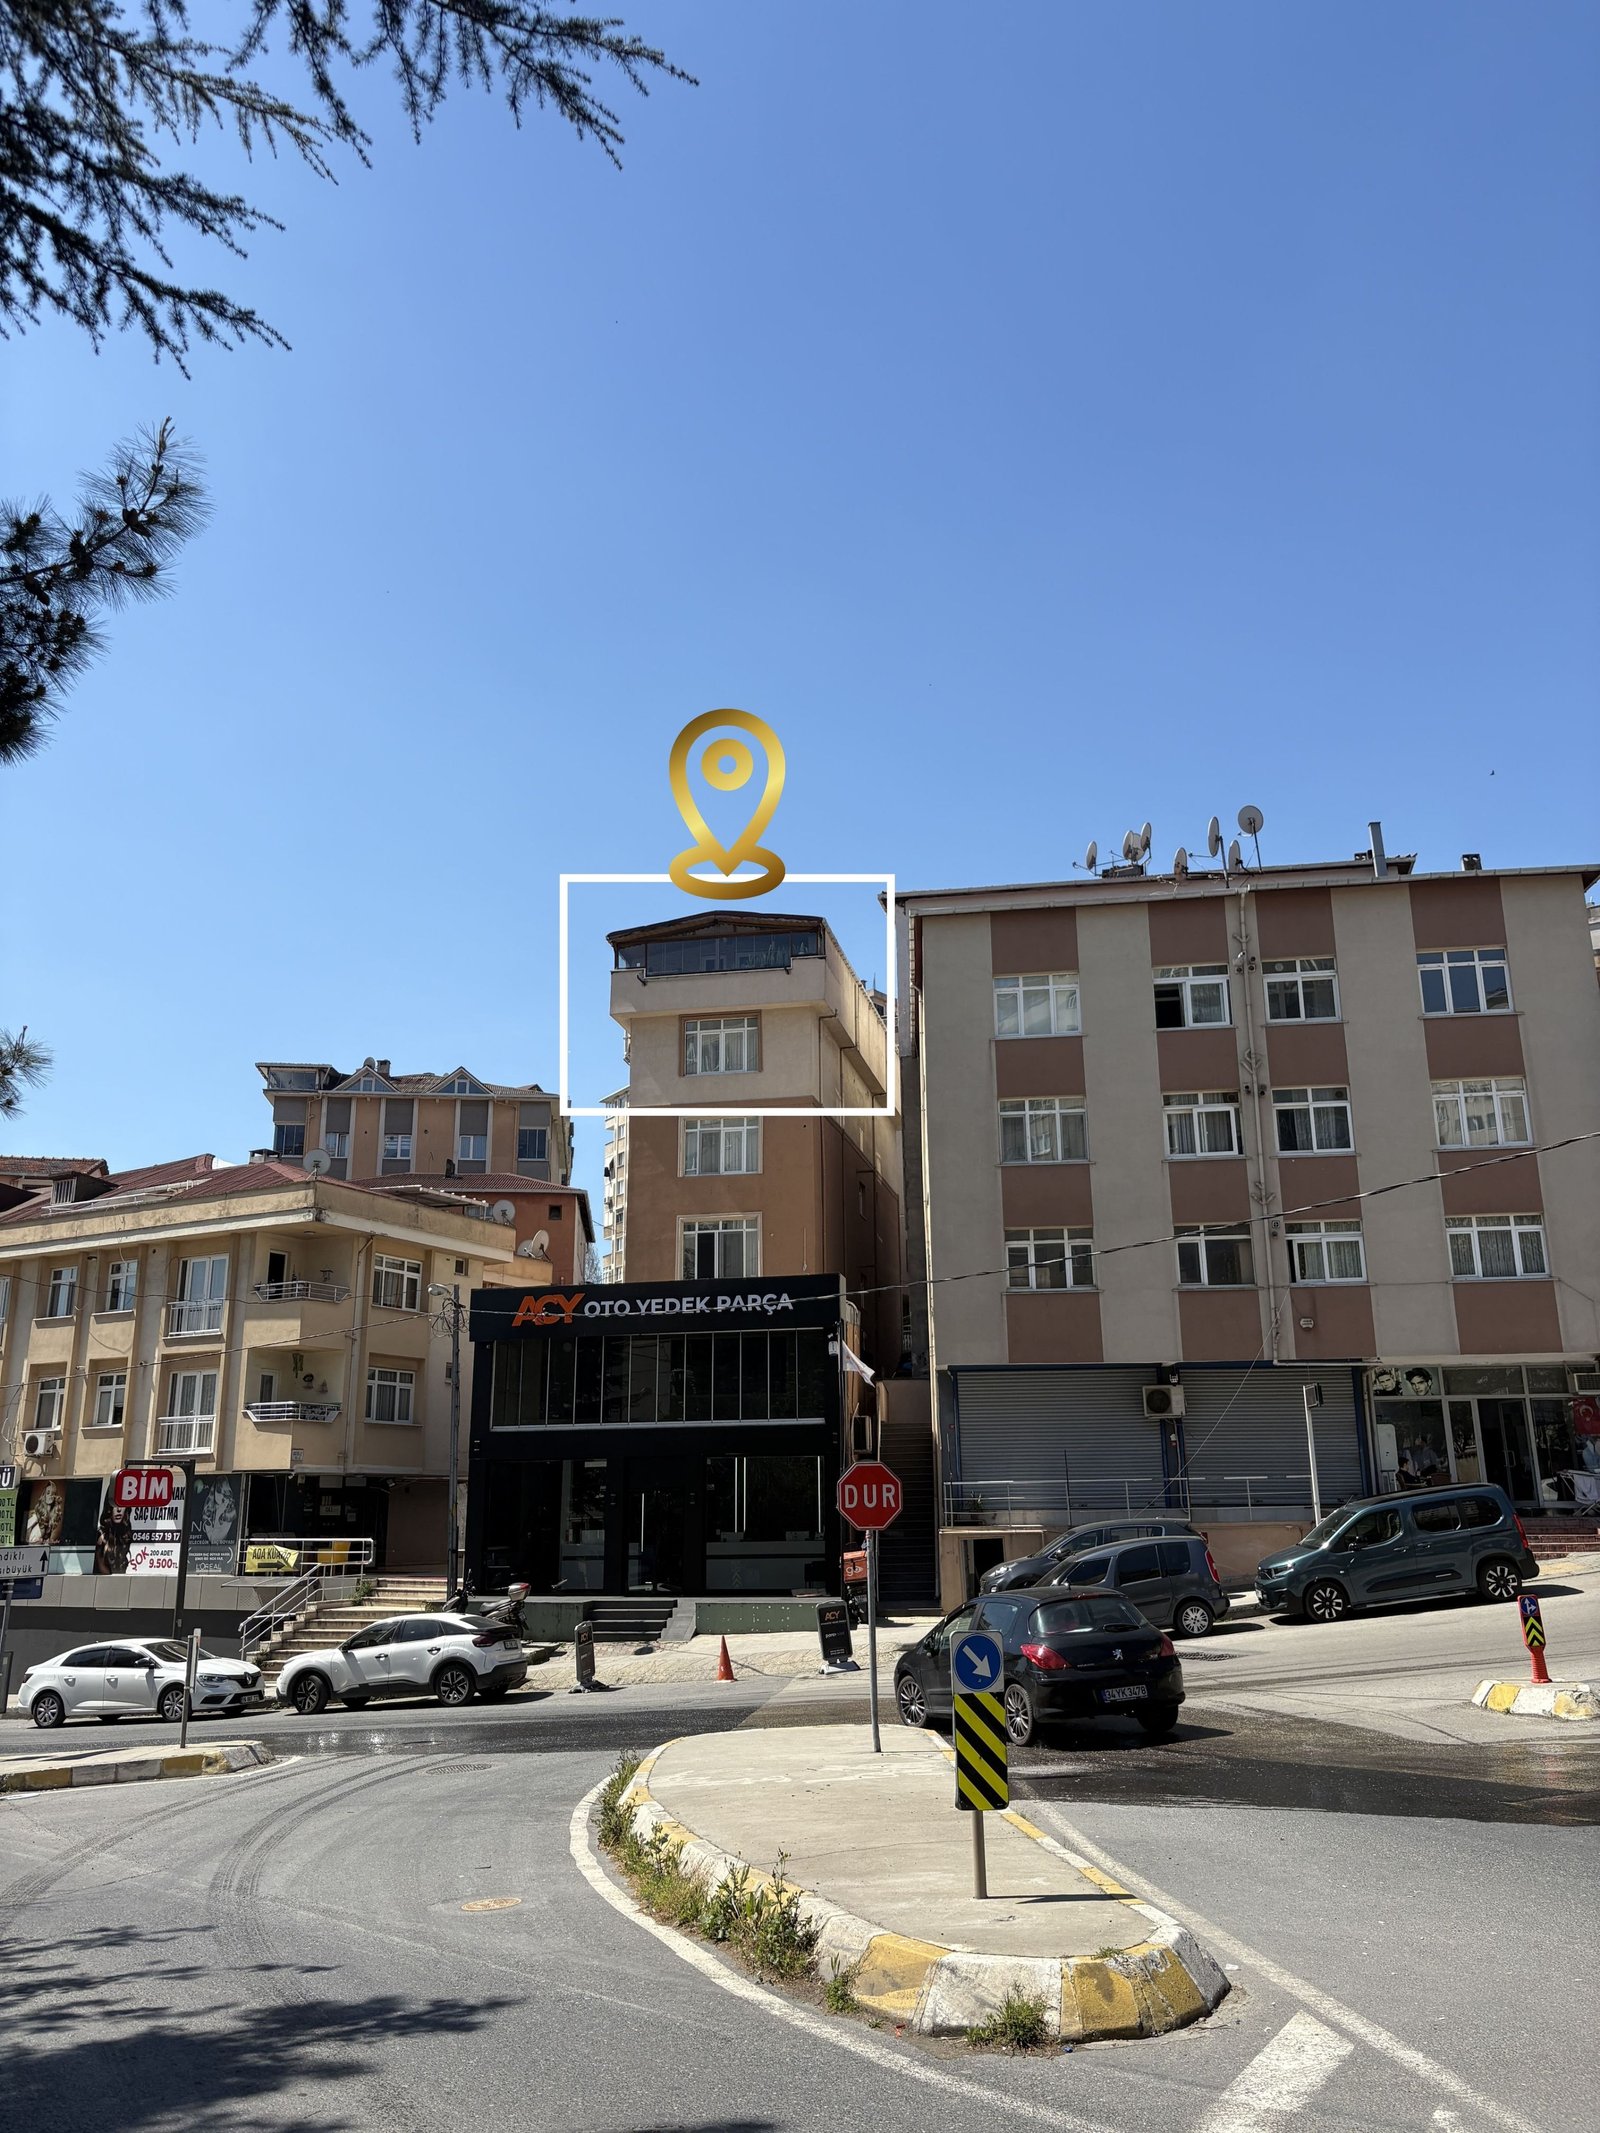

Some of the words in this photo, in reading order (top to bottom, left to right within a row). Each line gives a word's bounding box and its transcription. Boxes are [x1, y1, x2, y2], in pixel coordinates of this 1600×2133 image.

[512, 1293, 585, 1327] ACY
[584, 1299, 630, 1318] OTO
[636, 1296, 711, 1316] YEDEK
[717, 1293, 794, 1315] PARÇA
[0, 1467, 11, 1487] Ü
[121, 1471, 168, 1500] BİM
[844, 1484, 896, 1509] DUR
[134, 1507, 149, 1523] SAÇ
[150, 1507, 178, 1521] UZATMA
[132, 1532, 150, 1541] 0546
[151, 1532, 163, 1541] 557
[164, 1532, 172, 1541] 19
[173, 1532, 181, 1541] 17
[149, 1549, 160, 1557] 200
[160, 1549, 174, 1557] ADET
[1117, 1688, 1128, 1699] YK
